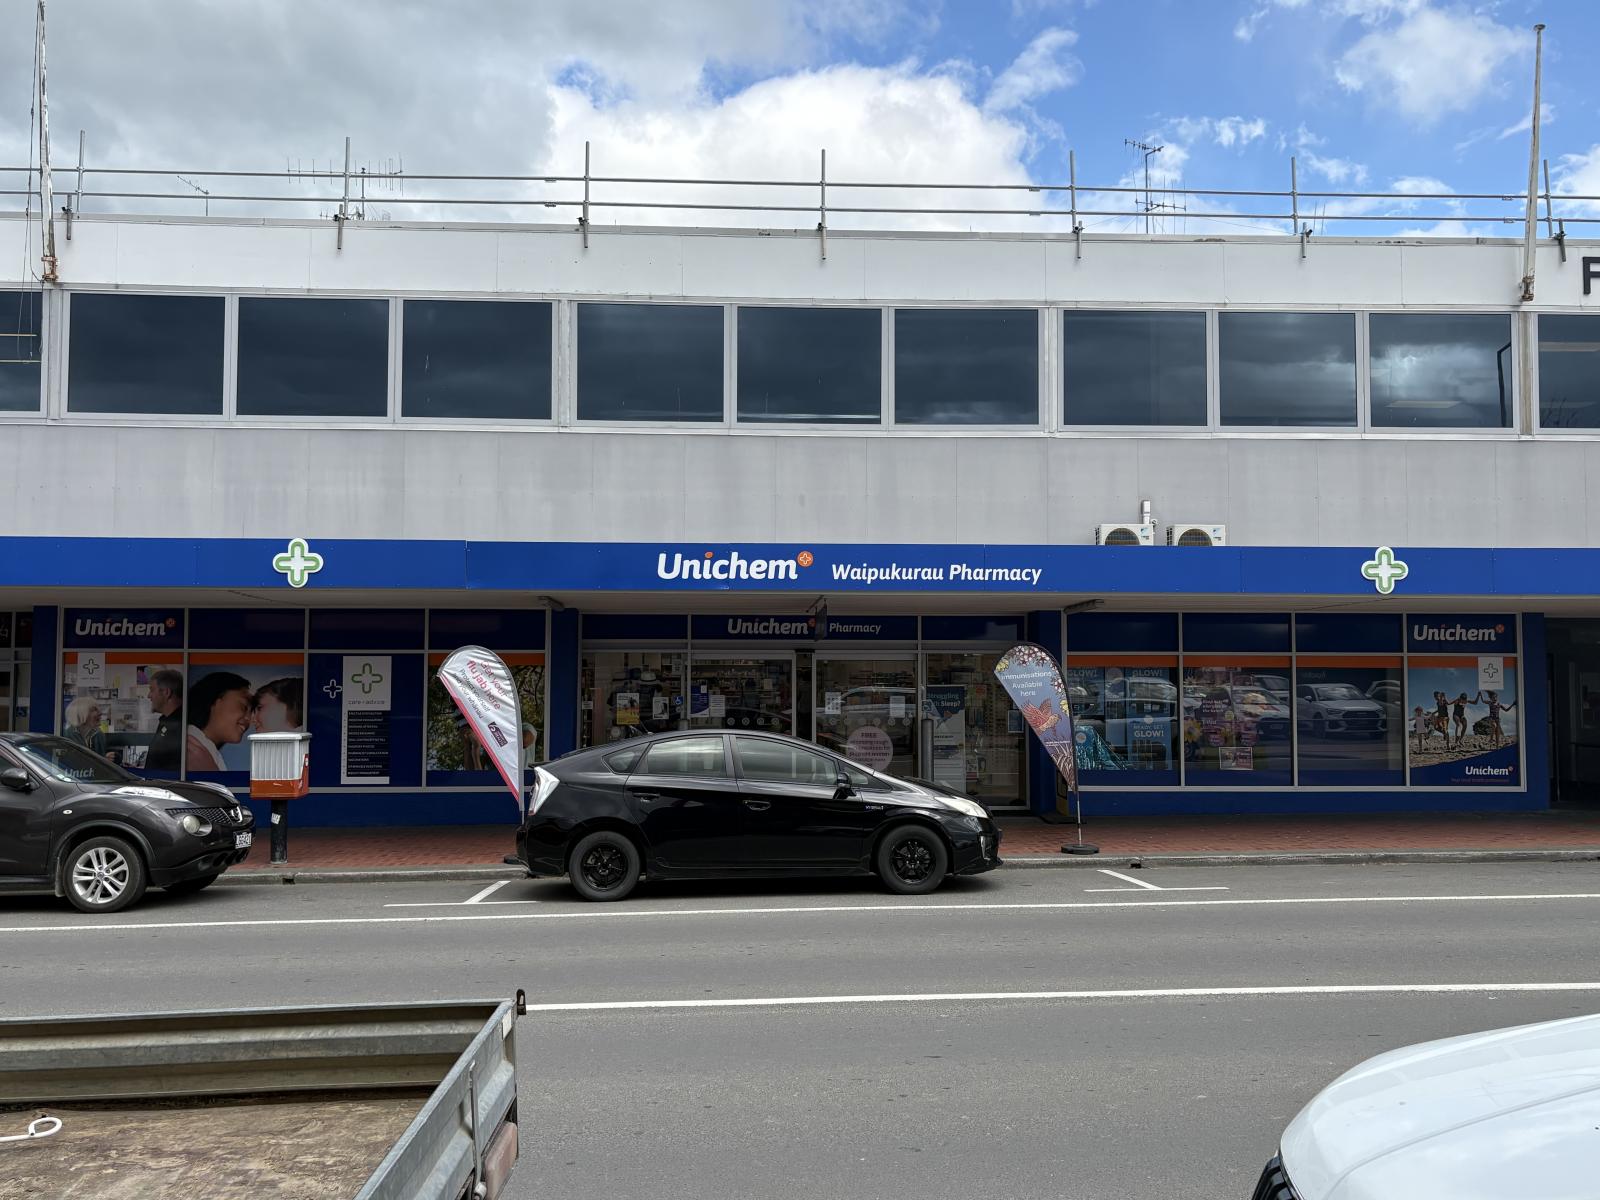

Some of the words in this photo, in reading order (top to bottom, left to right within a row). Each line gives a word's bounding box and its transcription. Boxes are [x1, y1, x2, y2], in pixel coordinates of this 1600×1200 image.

[656, 552, 798, 581] Unichem
[831, 563, 944, 584] Waipukurau
[949, 564, 1042, 585] Pharmacy
[74, 617, 166, 637] Unichem
[727, 617, 809, 635] Unichem
[829, 622, 882, 635] Pharmacy
[1413, 622, 1497, 641] Unichem
[481, 661, 495, 678] Get
[466, 659, 478, 675] flu
[472, 672, 488, 690] jab
[484, 689, 501, 710] here
[940, 700, 961, 708] Sleep?
[1134, 730, 1164, 738] GLOW!
[1465, 765, 1509, 776] Unichem
